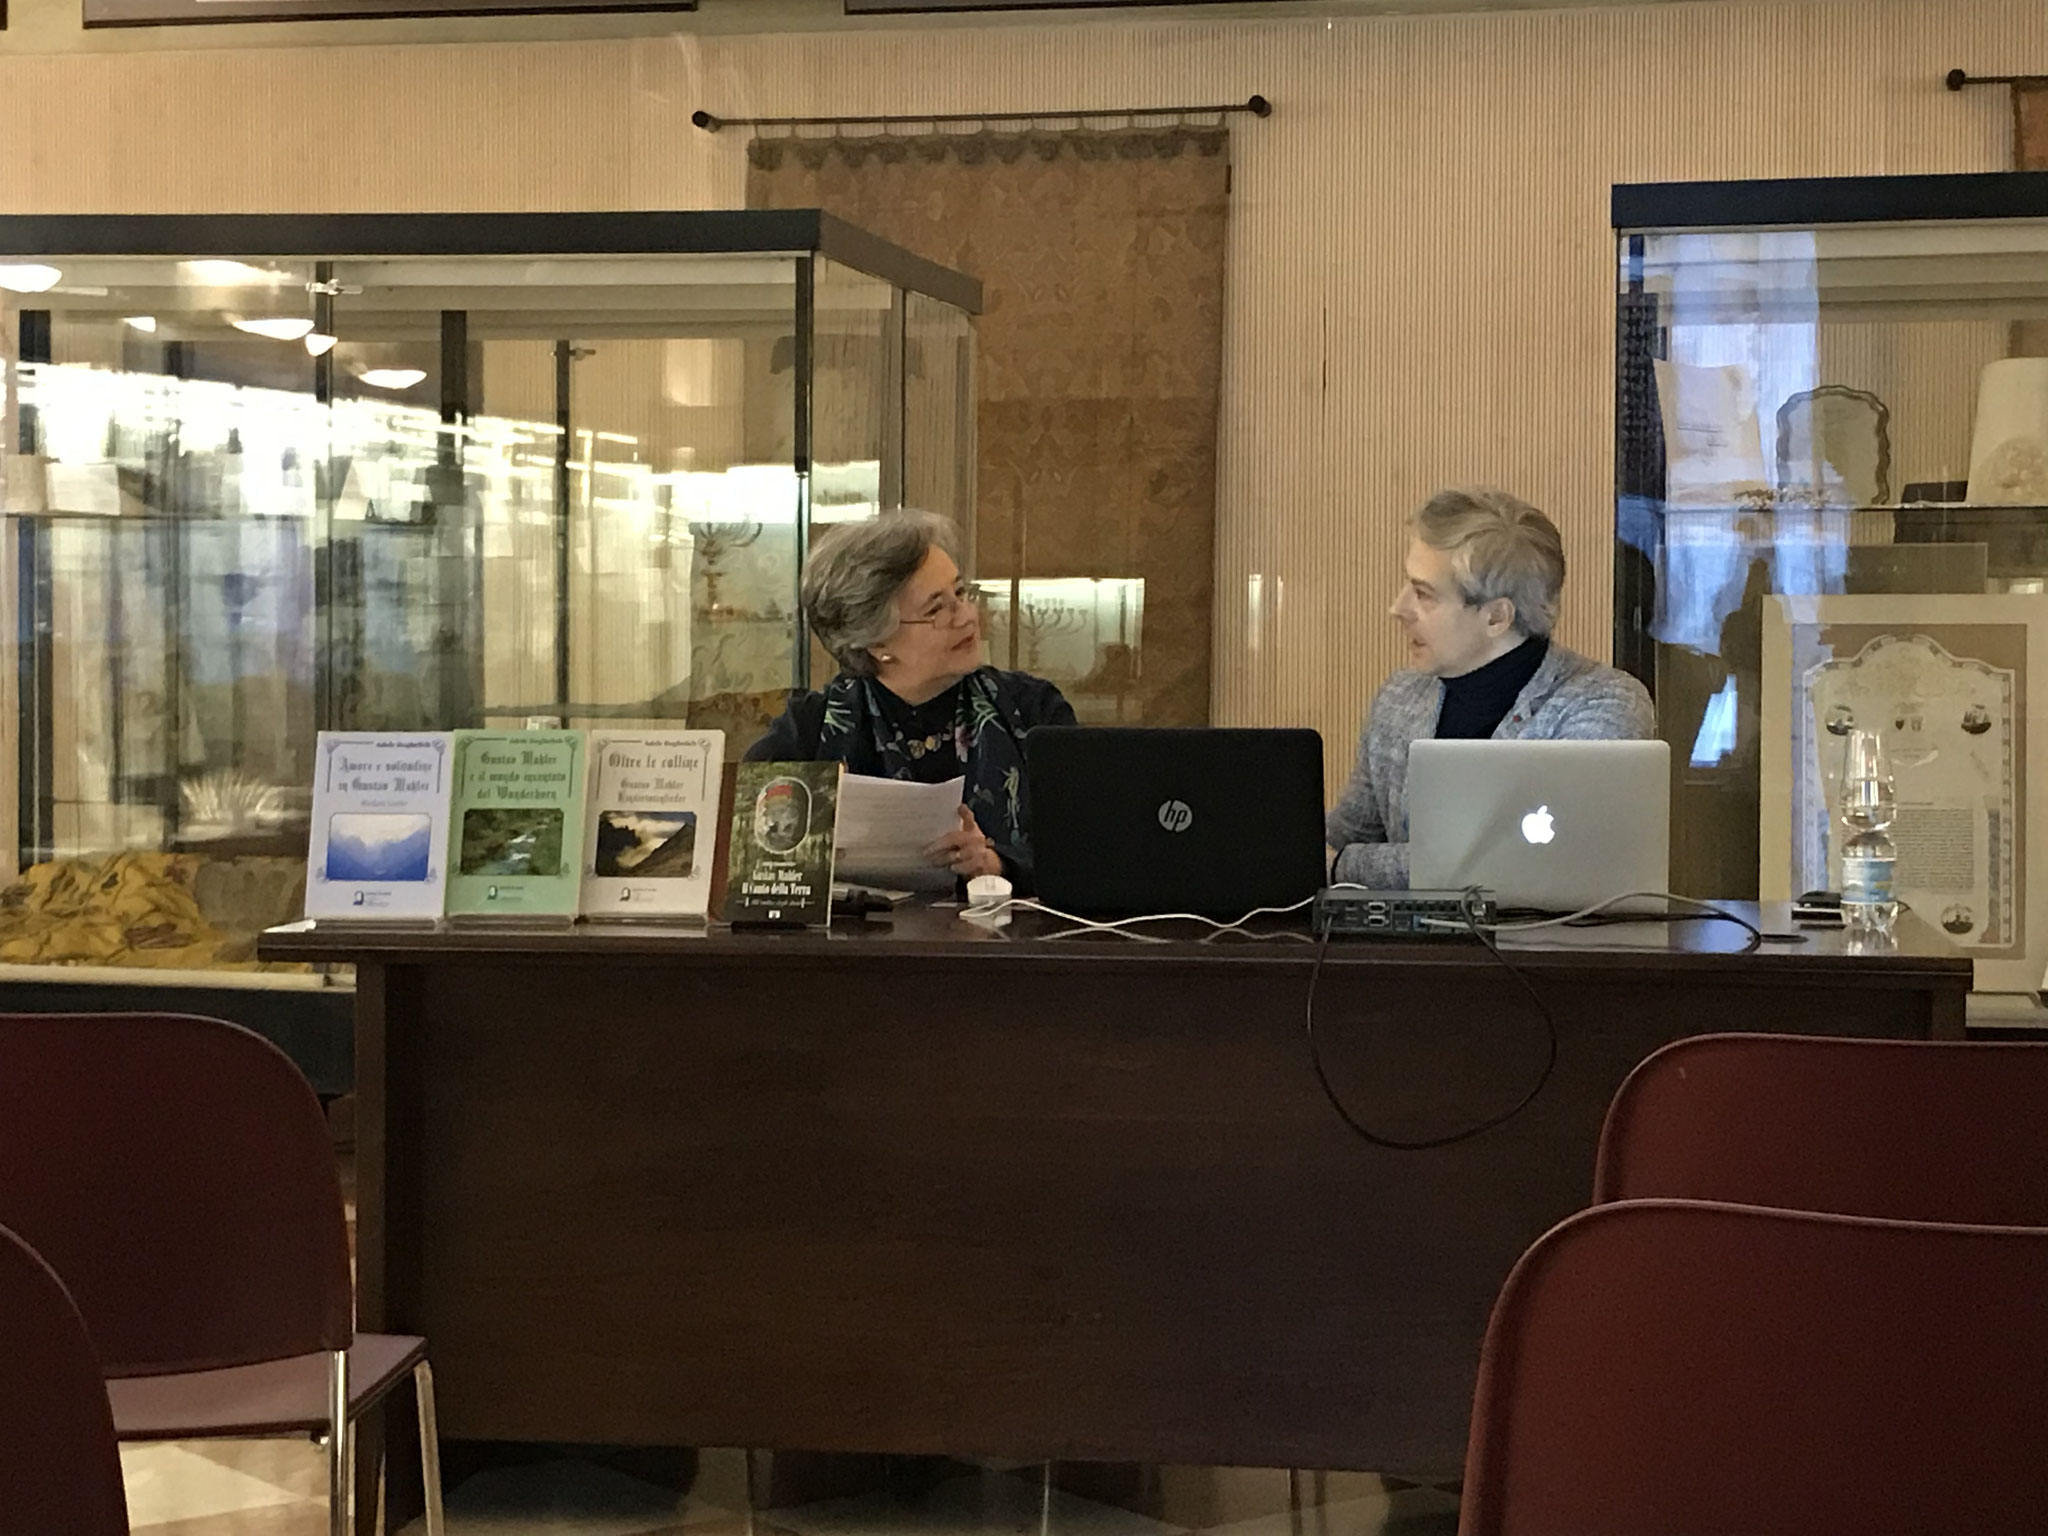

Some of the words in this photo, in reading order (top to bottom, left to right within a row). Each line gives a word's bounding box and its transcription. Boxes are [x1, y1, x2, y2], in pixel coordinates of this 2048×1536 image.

[338, 756, 373, 772] Amore
[480, 751, 517, 765] Gustav
[521, 750, 557, 765] Mahler
[608, 752, 641, 768] Oltre
[646, 753, 656, 768] le
[661, 754, 699, 771] colline
[352, 776, 389, 791] Gustav
[394, 777, 430, 792] Mahler
[1160, 799, 1191, 832] hp
[790, 882, 811, 896] Terra
